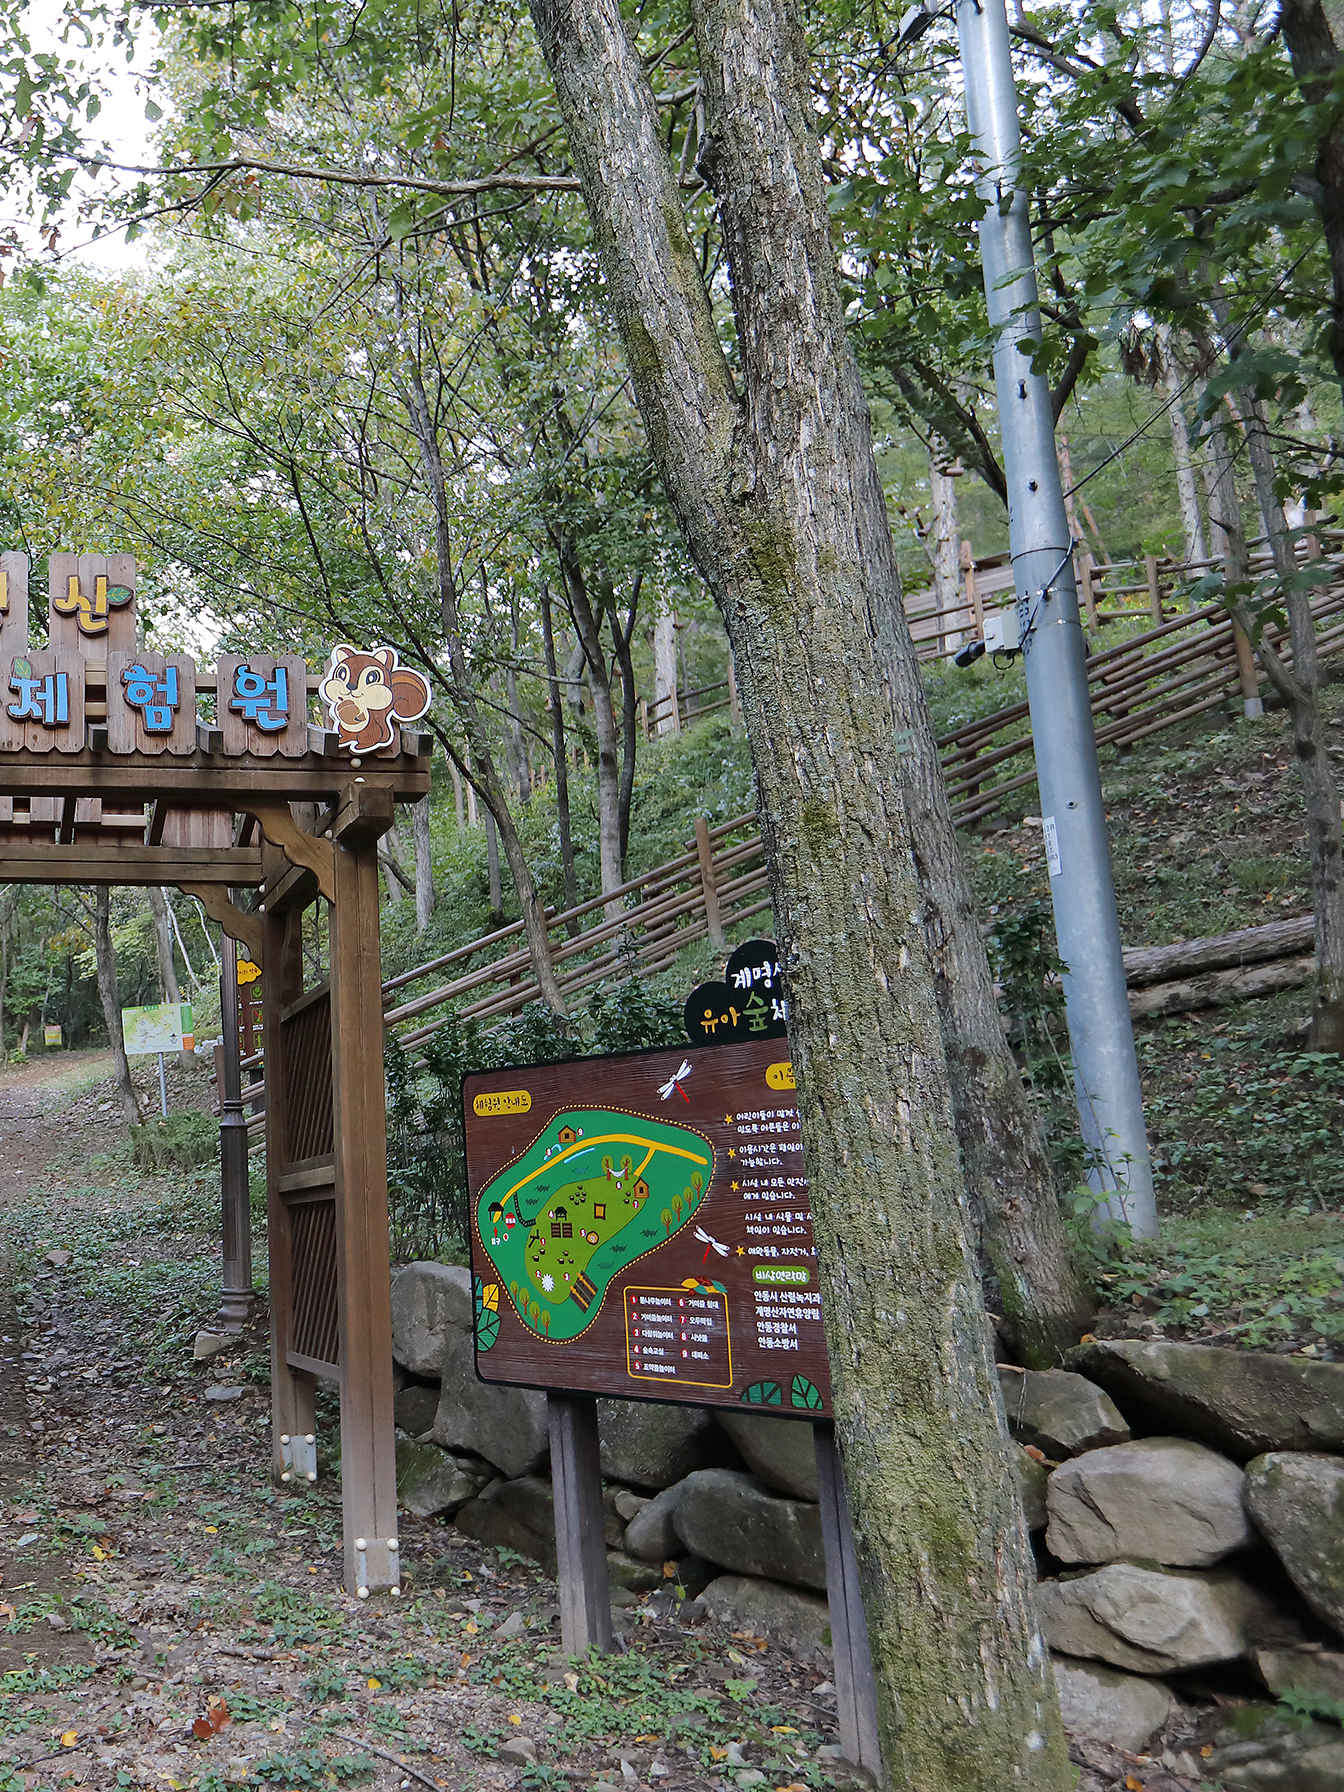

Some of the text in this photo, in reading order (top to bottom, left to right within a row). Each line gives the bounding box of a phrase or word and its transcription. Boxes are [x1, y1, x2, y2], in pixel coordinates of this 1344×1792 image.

[475, 1095, 529, 1111] 체험원 안내도
[736, 1110, 774, 1121] 어린이들이
[737, 1123, 759, 1134] 있도록
[760, 1121, 789, 1133] 어른들은
[739, 1143, 776, 1155] 이용시간은
[740, 1157, 783, 1168] 가능합니다.
[742, 1178, 759, 1188] 시설
[760, 1178, 769, 1187] 내
[770, 1177, 785, 1187] 모든
[743, 1190, 796, 1201] 에게 있습니다.
[744, 1212, 762, 1222] 시설
[764, 1212, 773, 1221] 내
[776, 1211, 792, 1222] 식물
[746, 1224, 807, 1236] 책임이 있습니다.
[747, 1246, 780, 1257] 애완동물,
[781, 1246, 809, 1257] 자전거,
[755, 1270, 807, 1282] 비상연락망
[754, 1290, 821, 1305] 안동시 산림녹지과
[755, 1305, 820, 1320] 계명산자연휴양림
[756, 1321, 798, 1335] 안동경찰서
[757, 1336, 799, 1351] 안동소방서
[691, 1350, 710, 1360] 대피소
